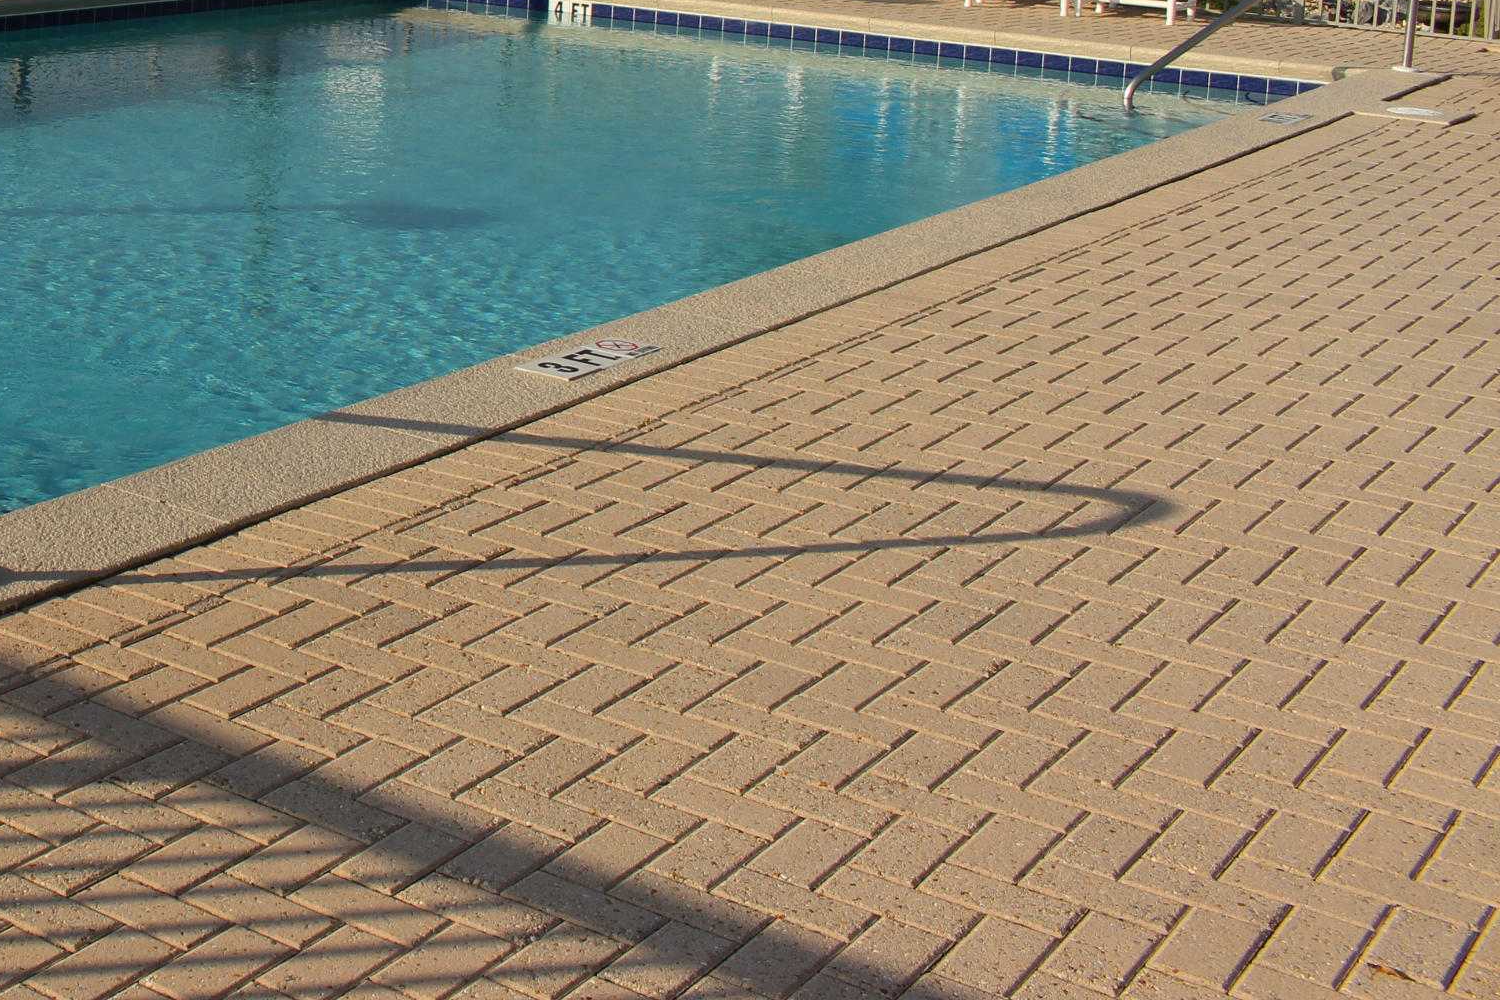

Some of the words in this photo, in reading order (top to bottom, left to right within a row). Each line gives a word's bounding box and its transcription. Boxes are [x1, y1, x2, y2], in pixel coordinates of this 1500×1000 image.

[555, 1, 563, 15] 4
[572, 3, 589, 17] FT
[537, 361, 580, 373] 3
[562, 349, 622, 367] FT
